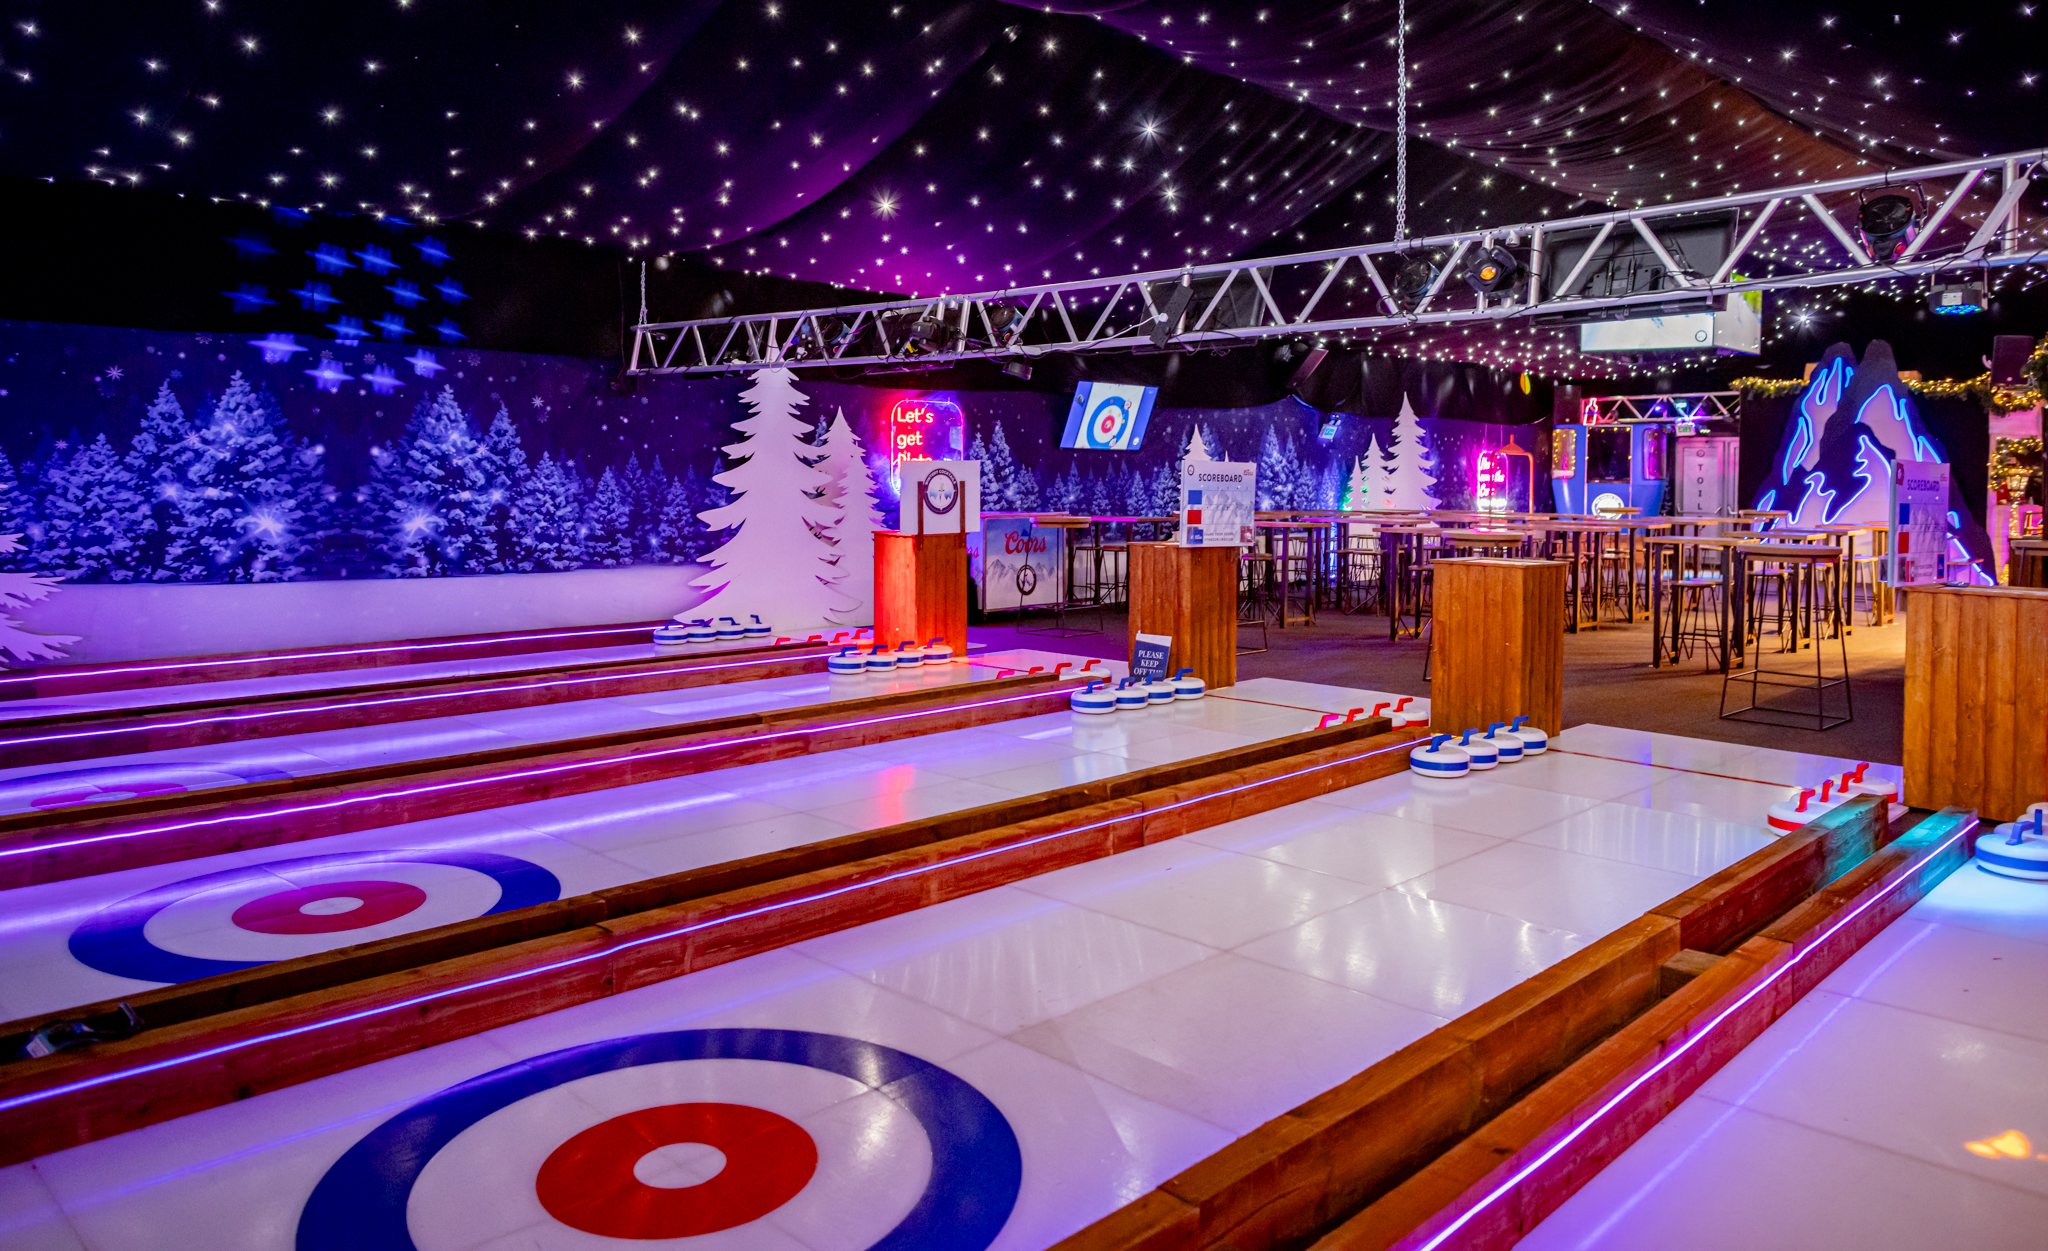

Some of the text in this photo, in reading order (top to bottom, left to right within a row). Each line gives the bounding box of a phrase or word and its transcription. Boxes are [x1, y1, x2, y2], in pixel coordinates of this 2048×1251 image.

[897, 406, 934, 423] Let's
[897, 431, 923, 449] get
[1198, 473, 1243, 483] SCOREBOARD
[1907, 479, 1940, 492] SCOREBOARD
[1005, 531, 1047, 554] Coors
[1138, 649, 1165, 660] PLEASE
[1140, 659, 1160, 668] KEEP
[1133, 667, 1148, 676] OFF
